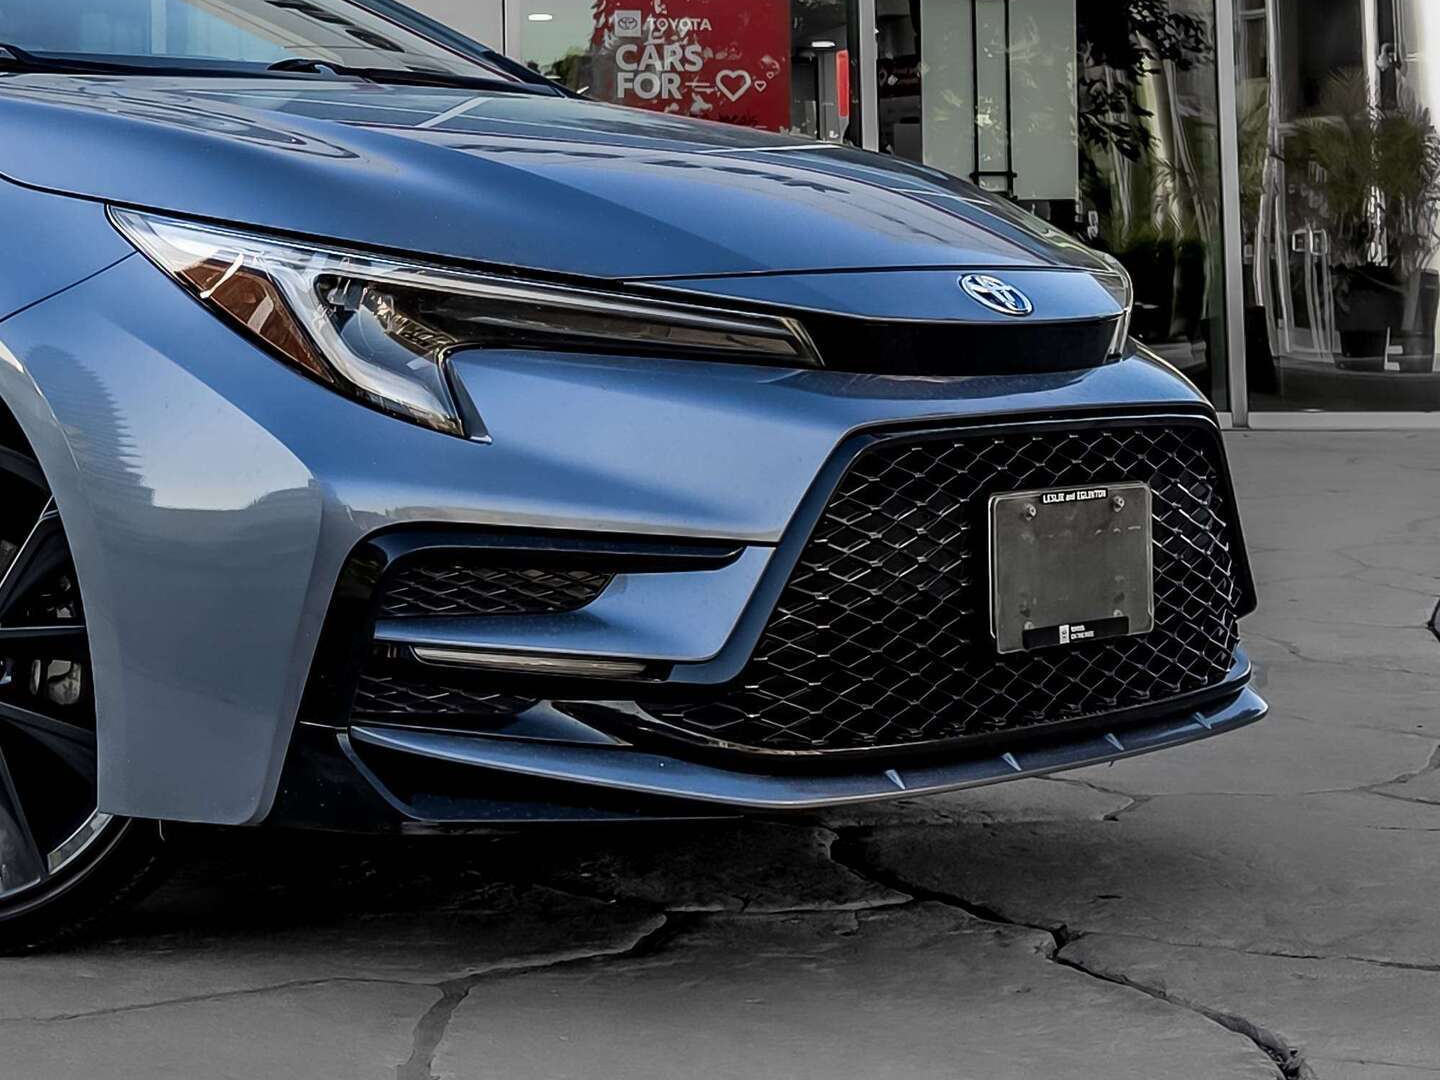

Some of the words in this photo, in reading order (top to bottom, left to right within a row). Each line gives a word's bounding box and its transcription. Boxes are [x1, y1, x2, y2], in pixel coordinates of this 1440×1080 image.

[646, 17, 713, 31] TOYOTA
[615, 44, 704, 72] CARS
[616, 72, 683, 100] FOR
